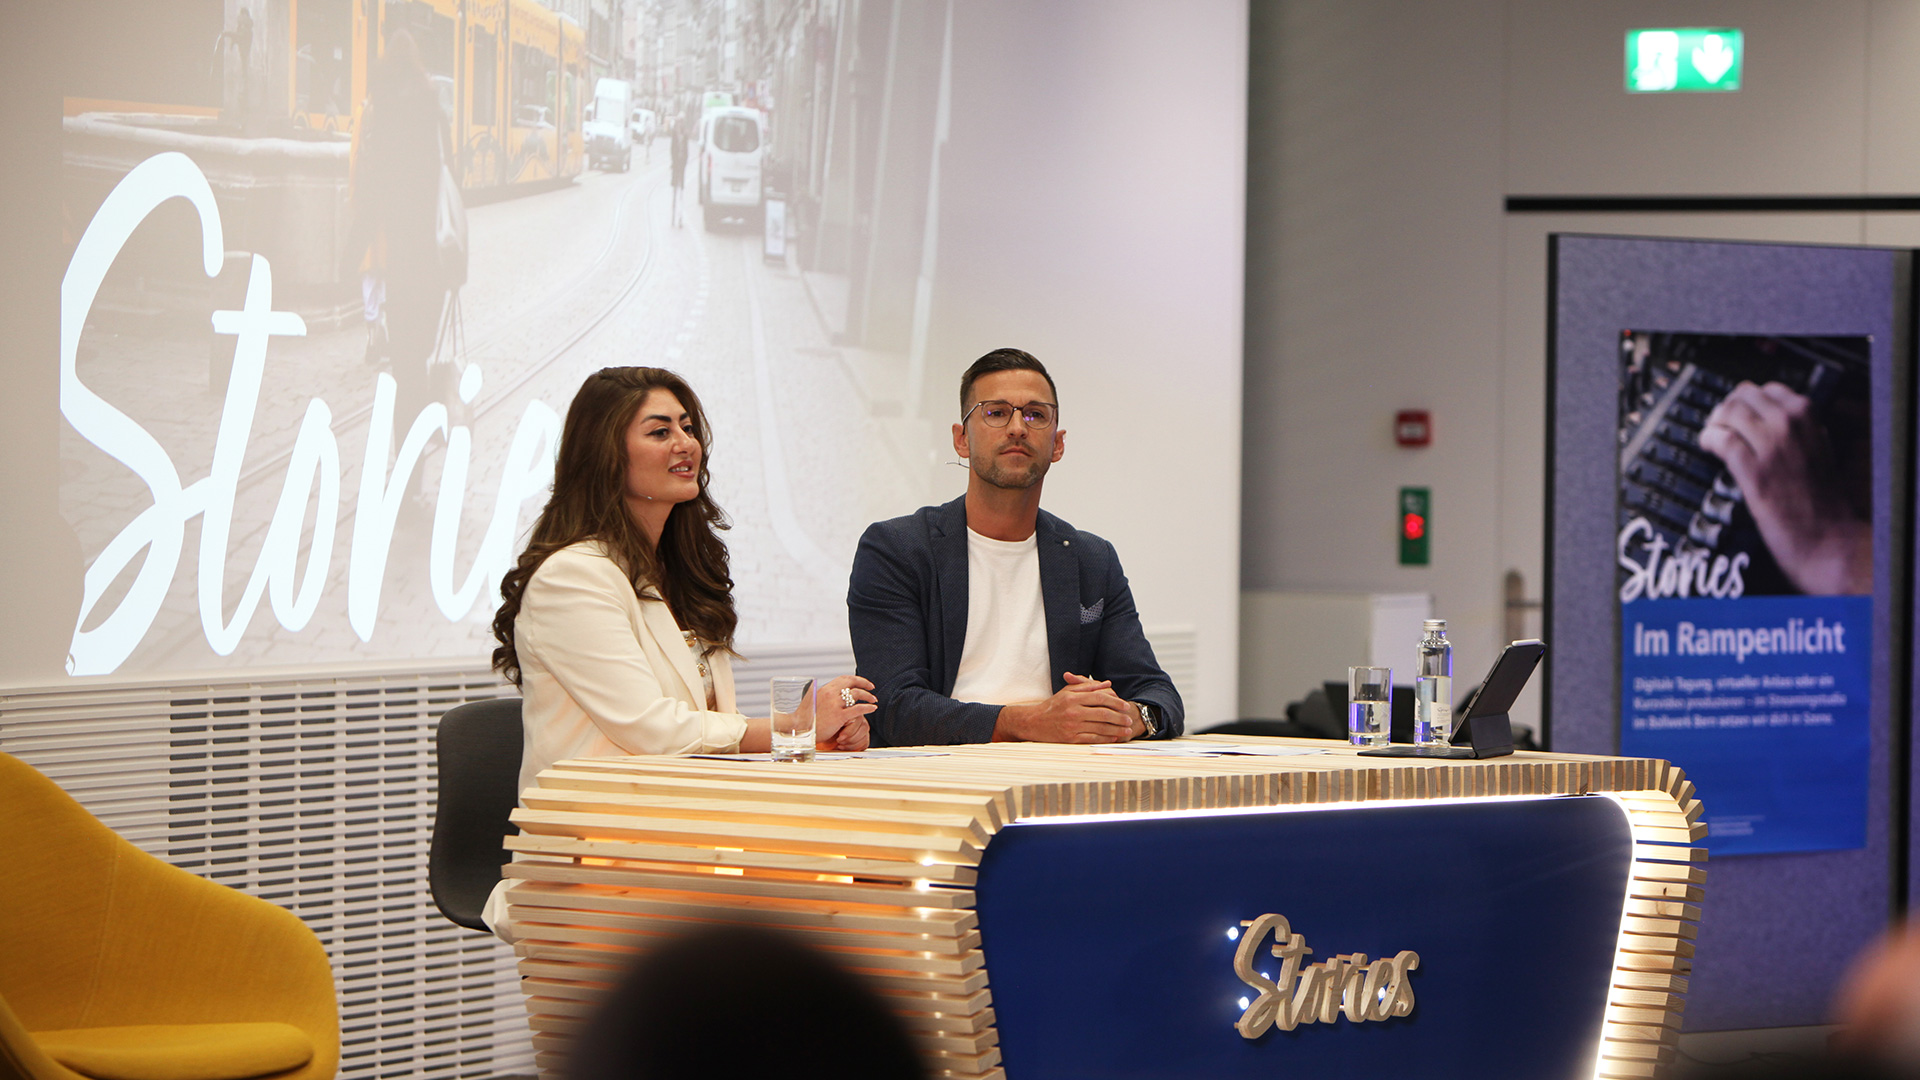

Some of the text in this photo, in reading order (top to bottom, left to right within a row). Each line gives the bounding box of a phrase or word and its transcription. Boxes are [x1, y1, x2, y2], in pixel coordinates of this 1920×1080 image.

[60, 152, 560, 676] Storie
[1618, 516, 1750, 604] Stories
[1633, 616, 1846, 664] Im Rampenlicht
[1233, 913, 1420, 1040] Stories
